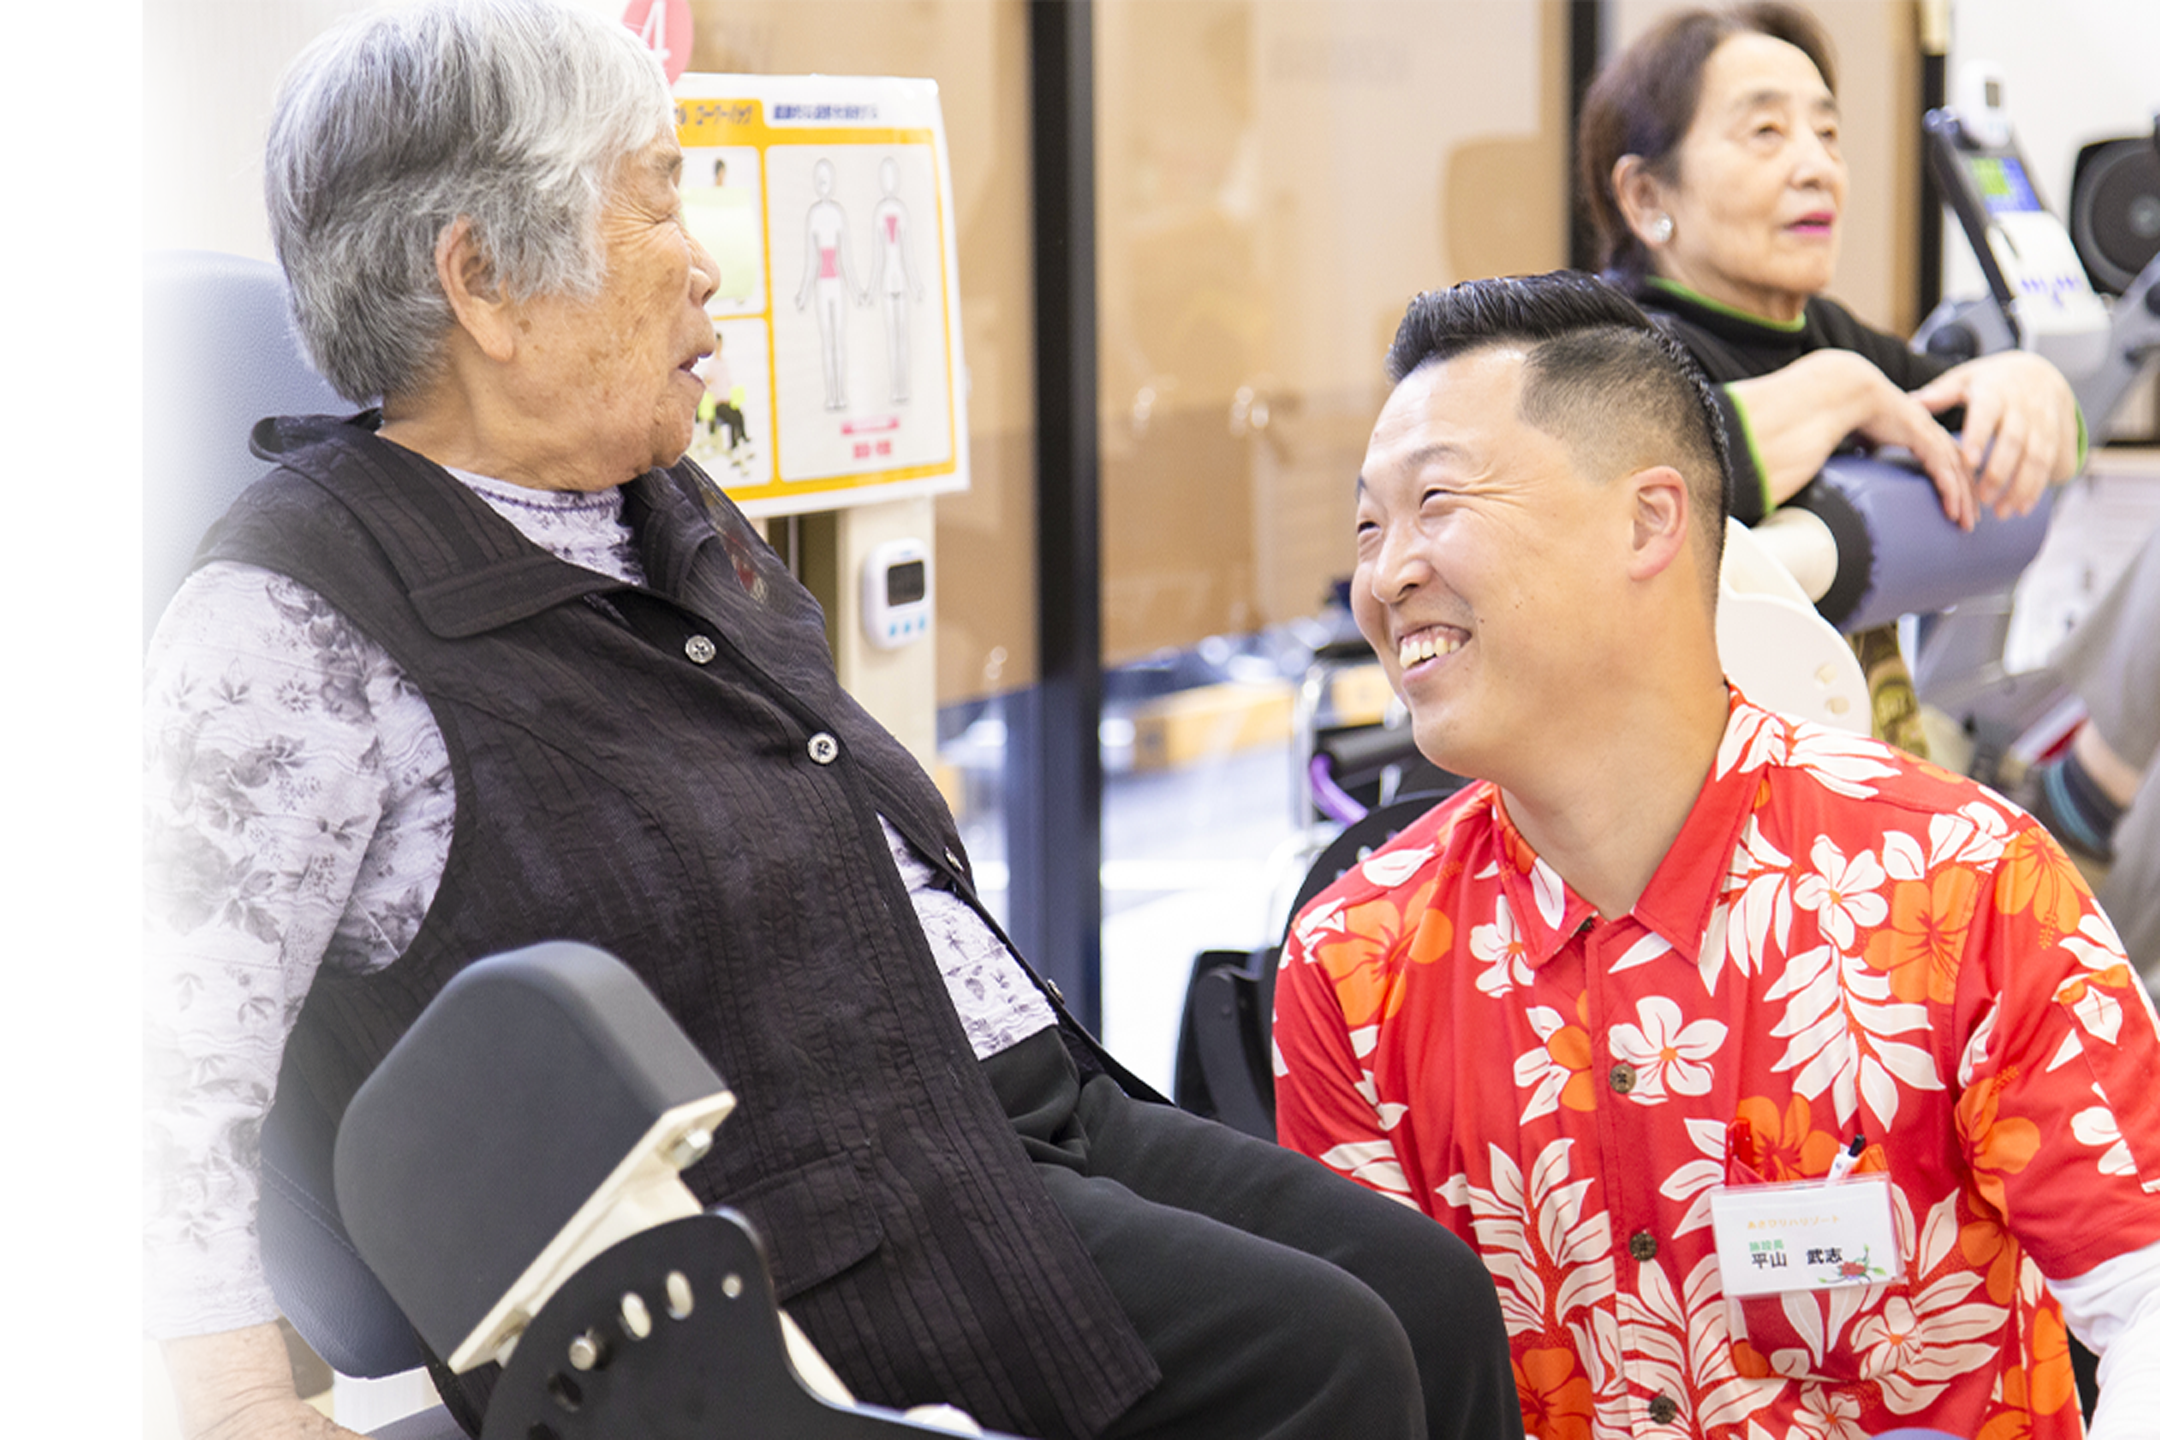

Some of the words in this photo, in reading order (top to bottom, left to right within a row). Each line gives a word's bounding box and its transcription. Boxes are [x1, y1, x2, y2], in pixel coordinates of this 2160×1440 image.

[641, 0, 671, 66] 4
[1752, 1251, 1788, 1269] 平山
[1807, 1247, 1842, 1265] 武志
